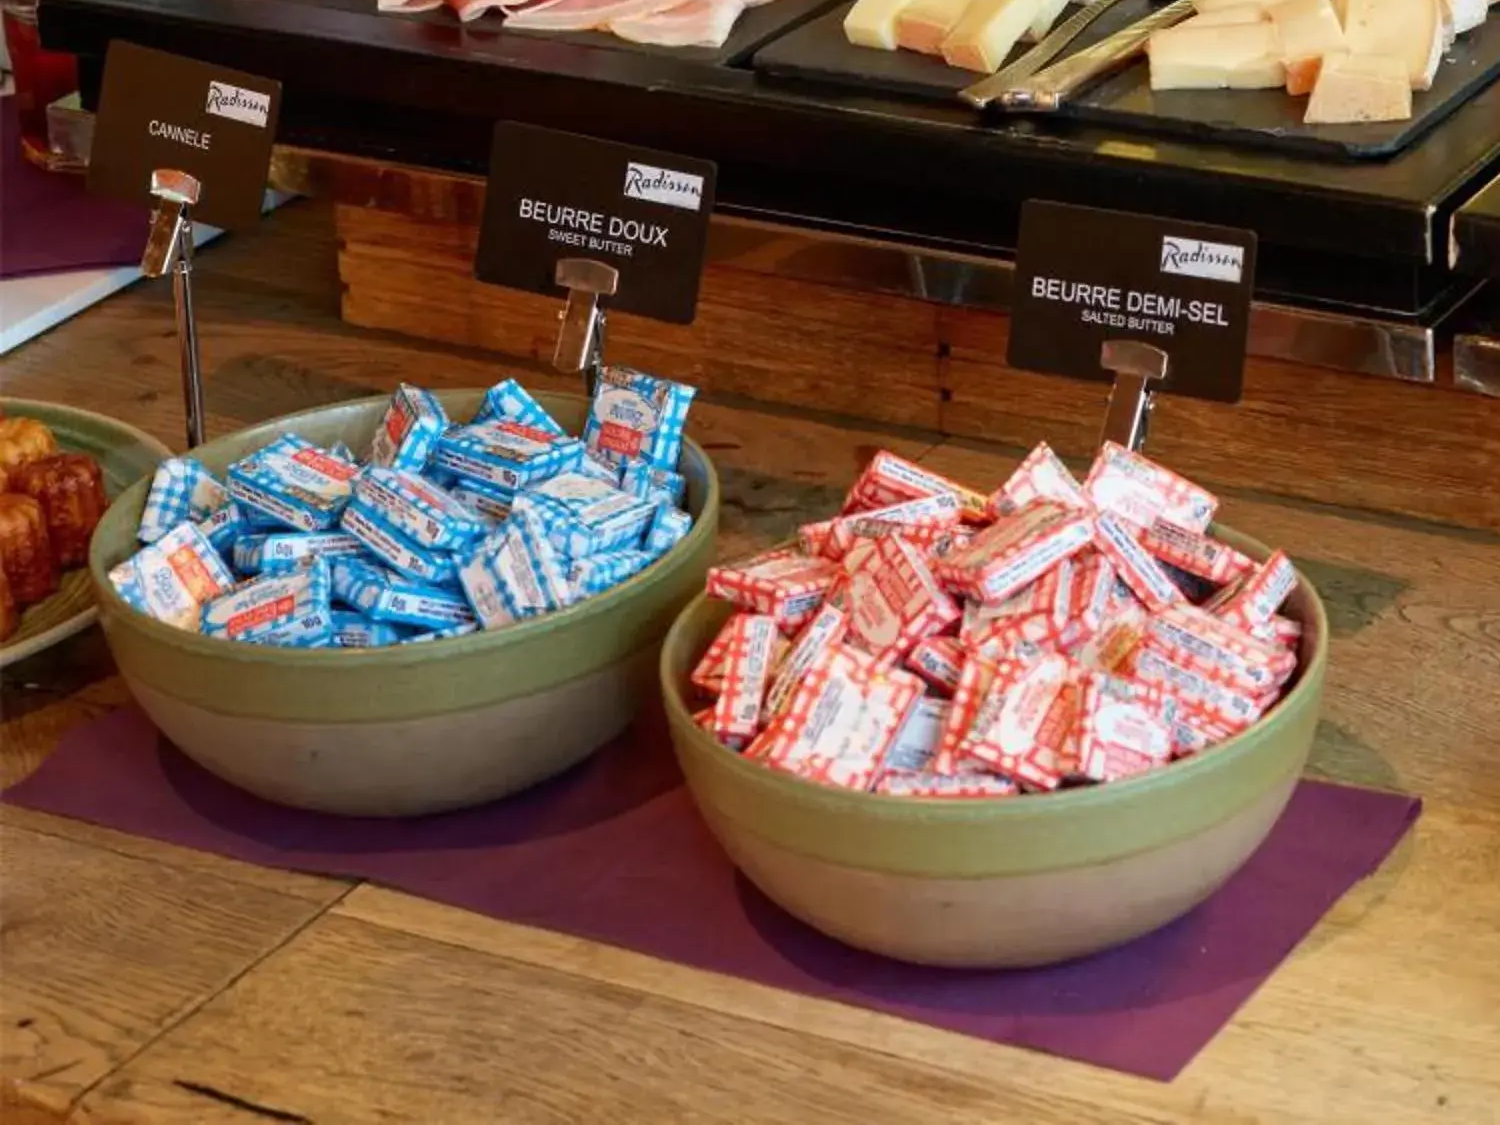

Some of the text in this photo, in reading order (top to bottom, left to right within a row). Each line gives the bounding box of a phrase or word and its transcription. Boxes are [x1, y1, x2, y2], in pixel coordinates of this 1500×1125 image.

[208, 84, 269, 115] Radisson
[149, 119, 212, 150] CANNELE
[625, 166, 702, 198] Radisson
[519, 197, 669, 247] BEURRE DOUX
[548, 228, 634, 257] SWEET BUTTER
[1161, 242, 1242, 269] Radisson
[1031, 276, 1230, 326] BEURRE DEMI-SEL
[1081, 309, 1175, 335] SALTED BUTTER
